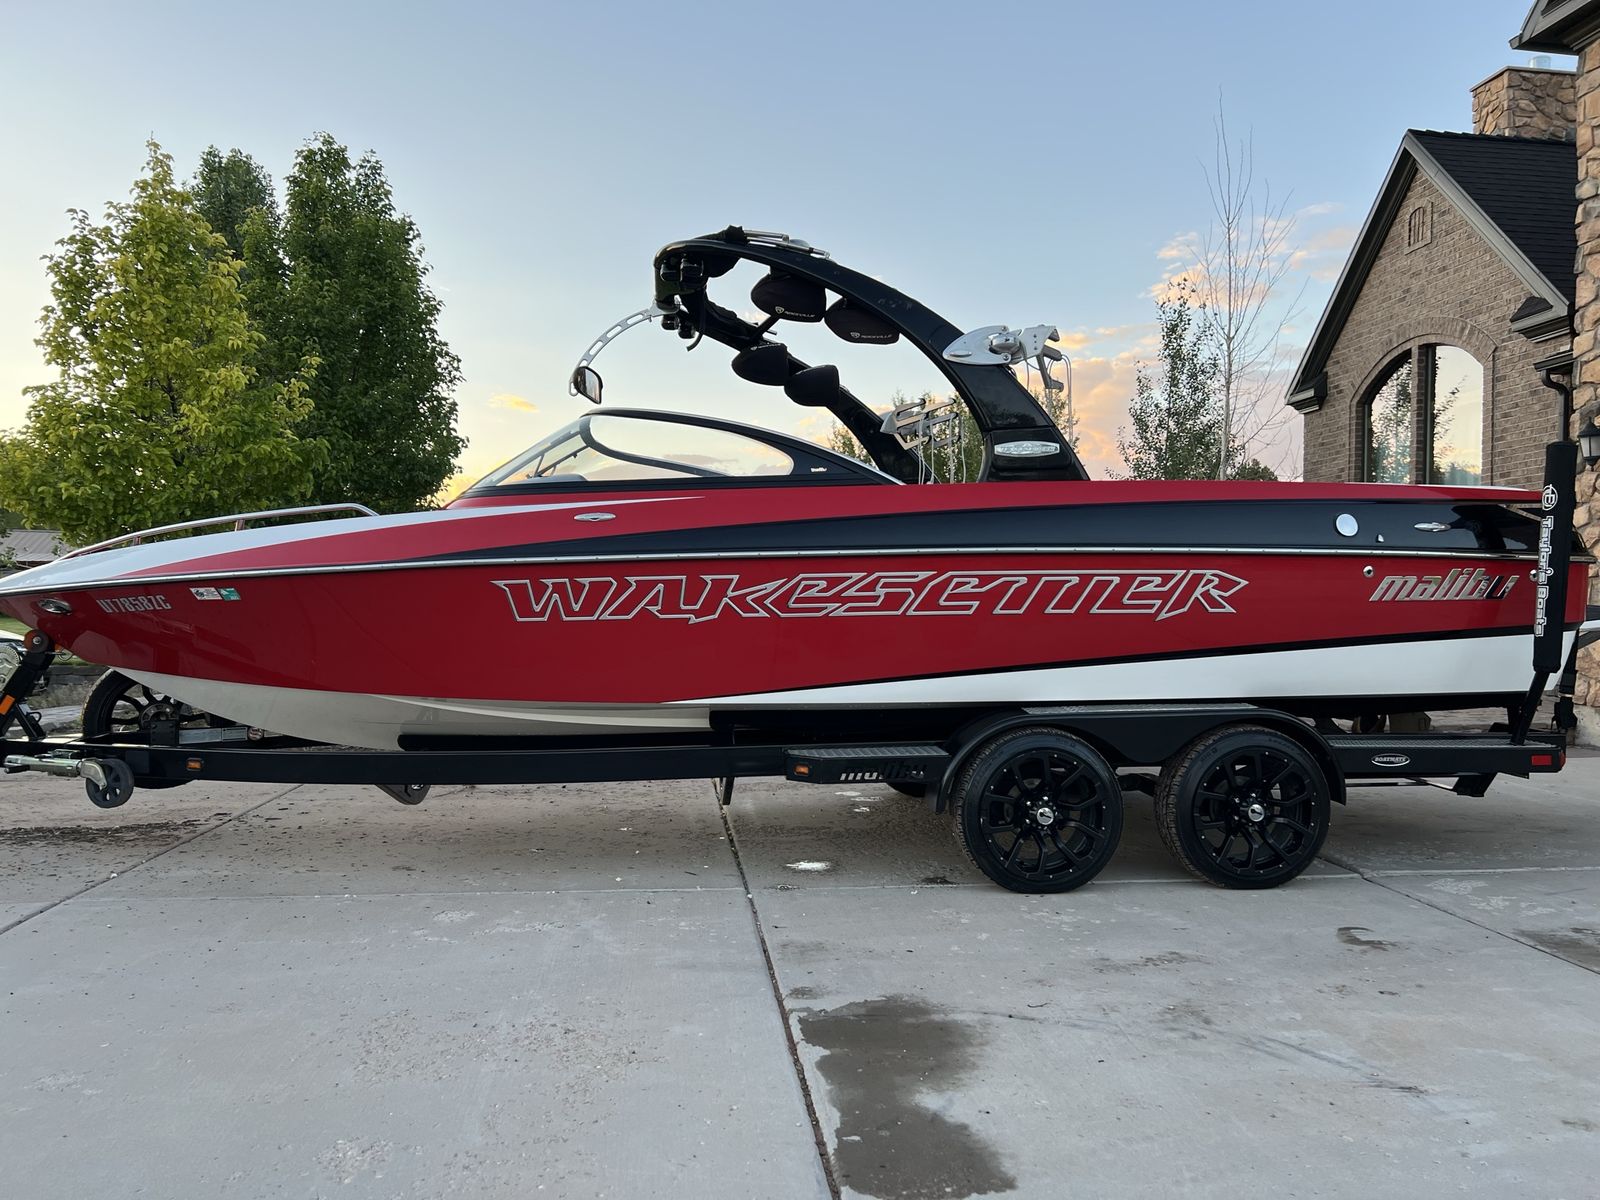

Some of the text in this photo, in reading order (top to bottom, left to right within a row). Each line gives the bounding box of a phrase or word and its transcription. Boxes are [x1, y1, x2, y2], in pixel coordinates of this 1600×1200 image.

[1538, 515, 1554, 585] Taylor's
[489, 568, 1250, 624] WAKESETTER
[1369, 567, 1520, 601] malibu
[1534, 585, 1549, 637] Boats
